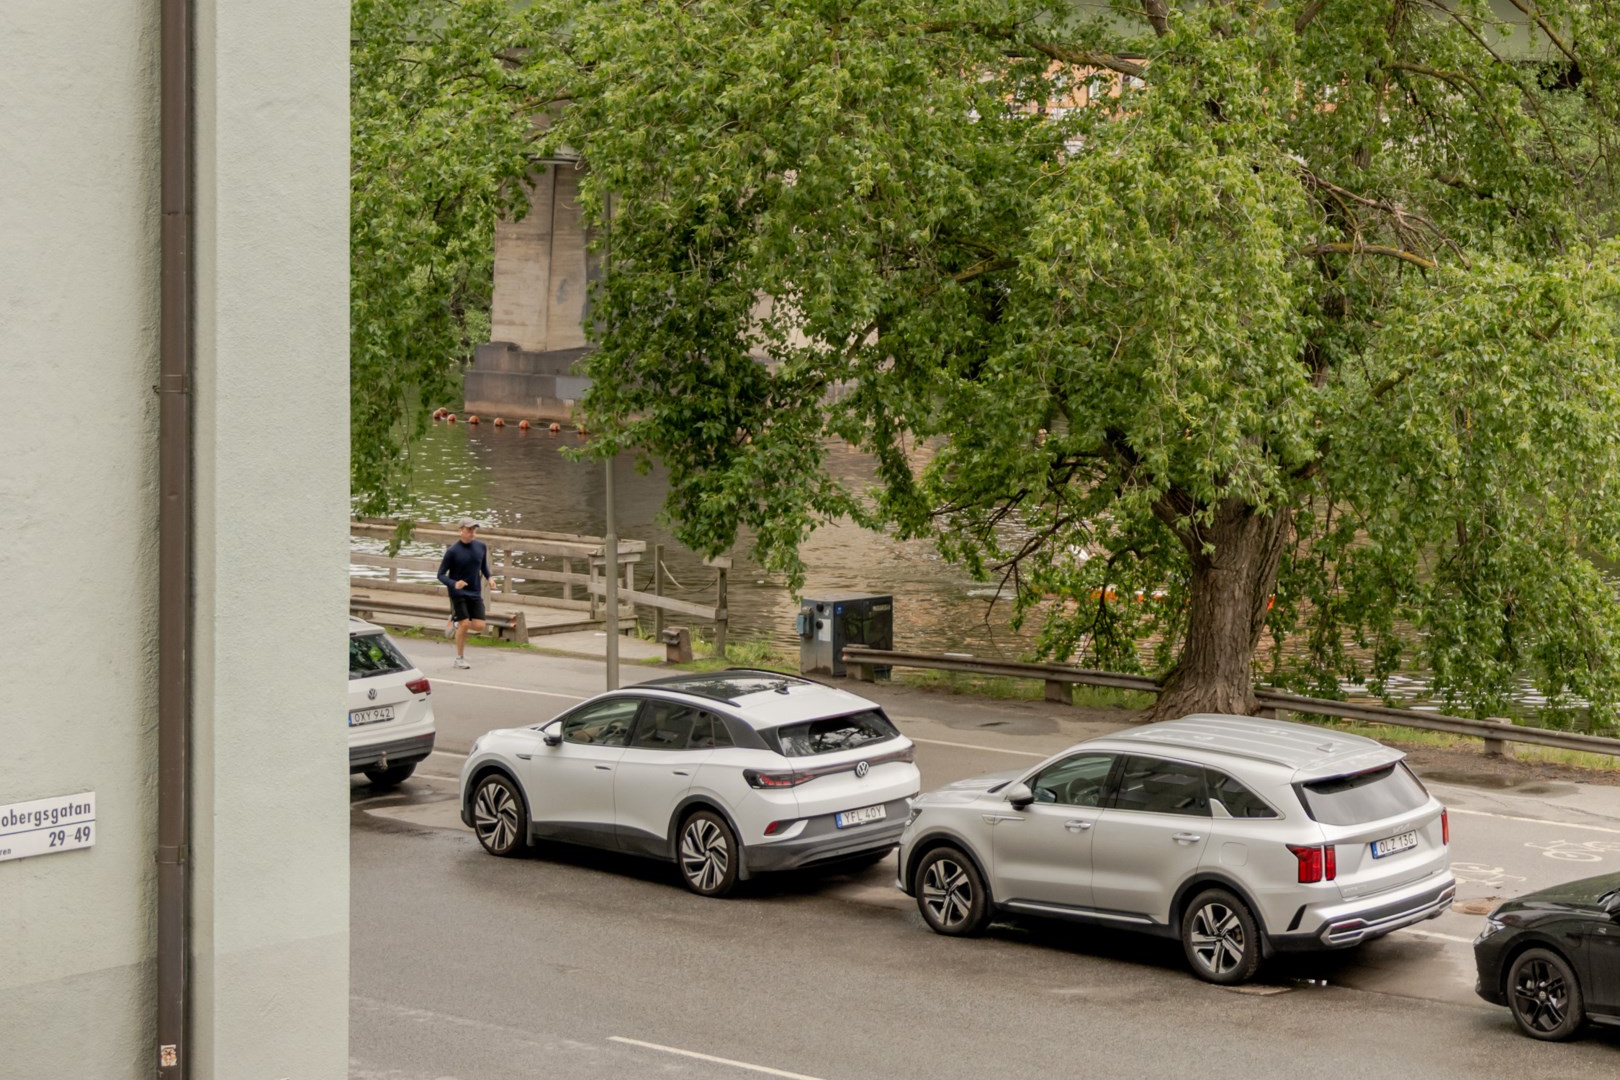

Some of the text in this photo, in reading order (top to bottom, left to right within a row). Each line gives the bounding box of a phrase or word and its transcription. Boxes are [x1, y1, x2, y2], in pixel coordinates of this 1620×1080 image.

[354, 708, 391, 723] OXY 942
[1, 803, 91, 828] obergsgatan
[844, 806, 882, 823] YFL 40Y
[1379, 833, 1414, 853] OLZ 13G
